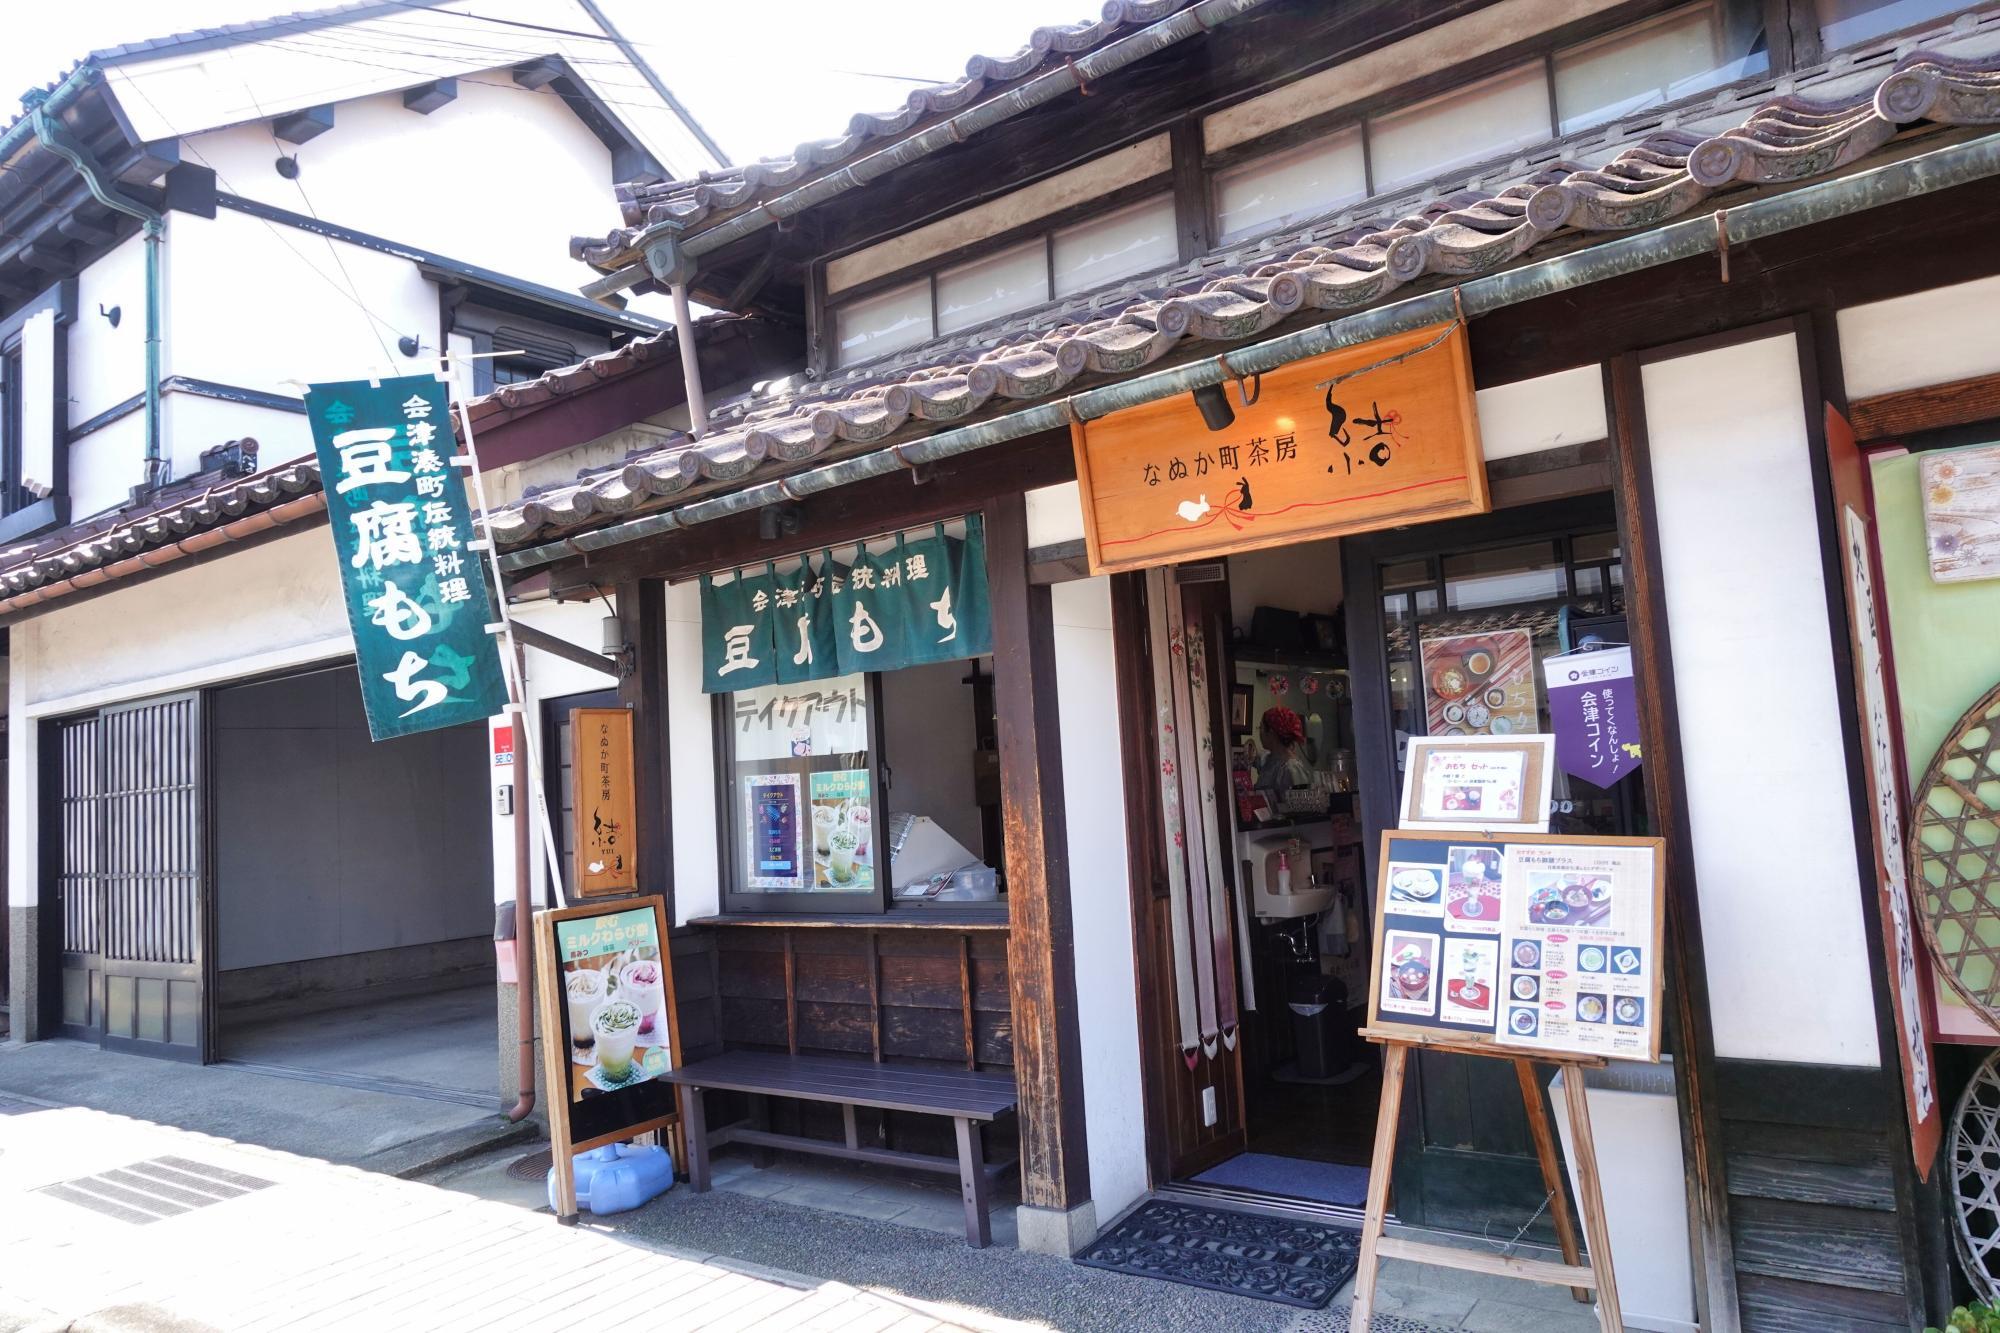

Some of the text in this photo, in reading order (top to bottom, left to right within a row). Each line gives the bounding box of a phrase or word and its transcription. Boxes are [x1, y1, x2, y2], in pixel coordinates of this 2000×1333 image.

[1143, 431, 1299, 487] なぬか町茶房
[401, 394, 472, 604] 会津湊町伝統料理
[332, 427, 449, 718] 豆腐もち
[717, 585, 957, 677] 豆もち
[735, 687, 866, 732] テイクアウト
[1580, 691, 1605, 769] 会津コイン
[600, 723, 611, 801] なぬか町茶房
